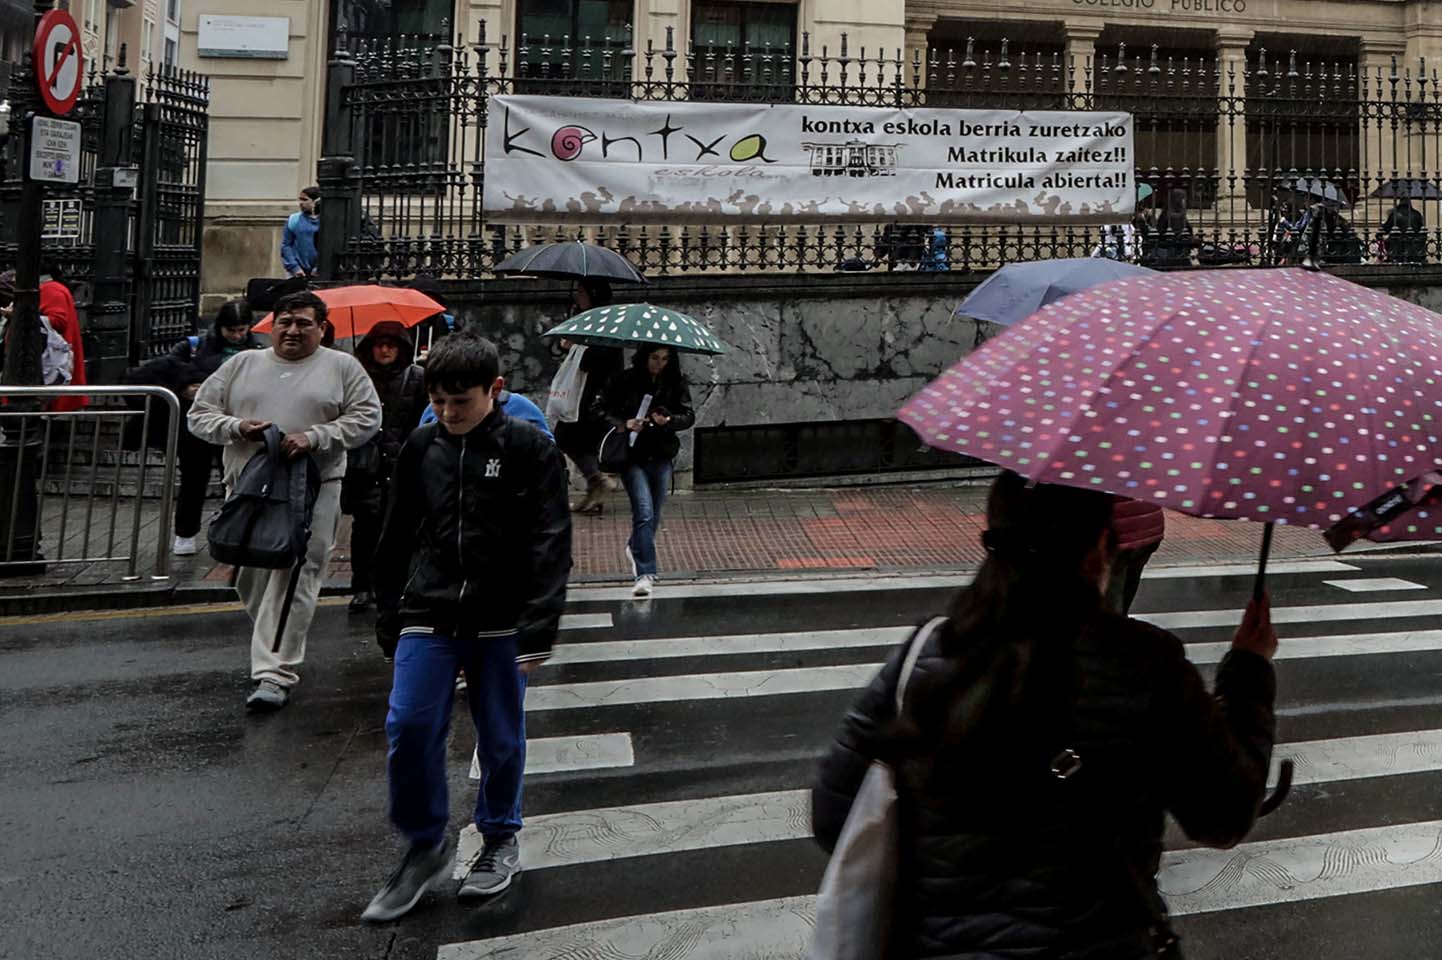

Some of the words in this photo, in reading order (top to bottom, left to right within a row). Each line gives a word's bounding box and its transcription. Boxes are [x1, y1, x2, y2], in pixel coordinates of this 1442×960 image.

[802, 116, 874, 135] kontxa
[883, 118, 950, 137] eskola
[959, 121, 1021, 137] berria
[1029, 122, 1126, 138] zuretzako
[947, 147, 1047, 163] Matrikula
[1056, 147, 1126, 164] zaitez!!
[935, 173, 1035, 189] Matricula
[1041, 173, 1127, 190] abierta!!
